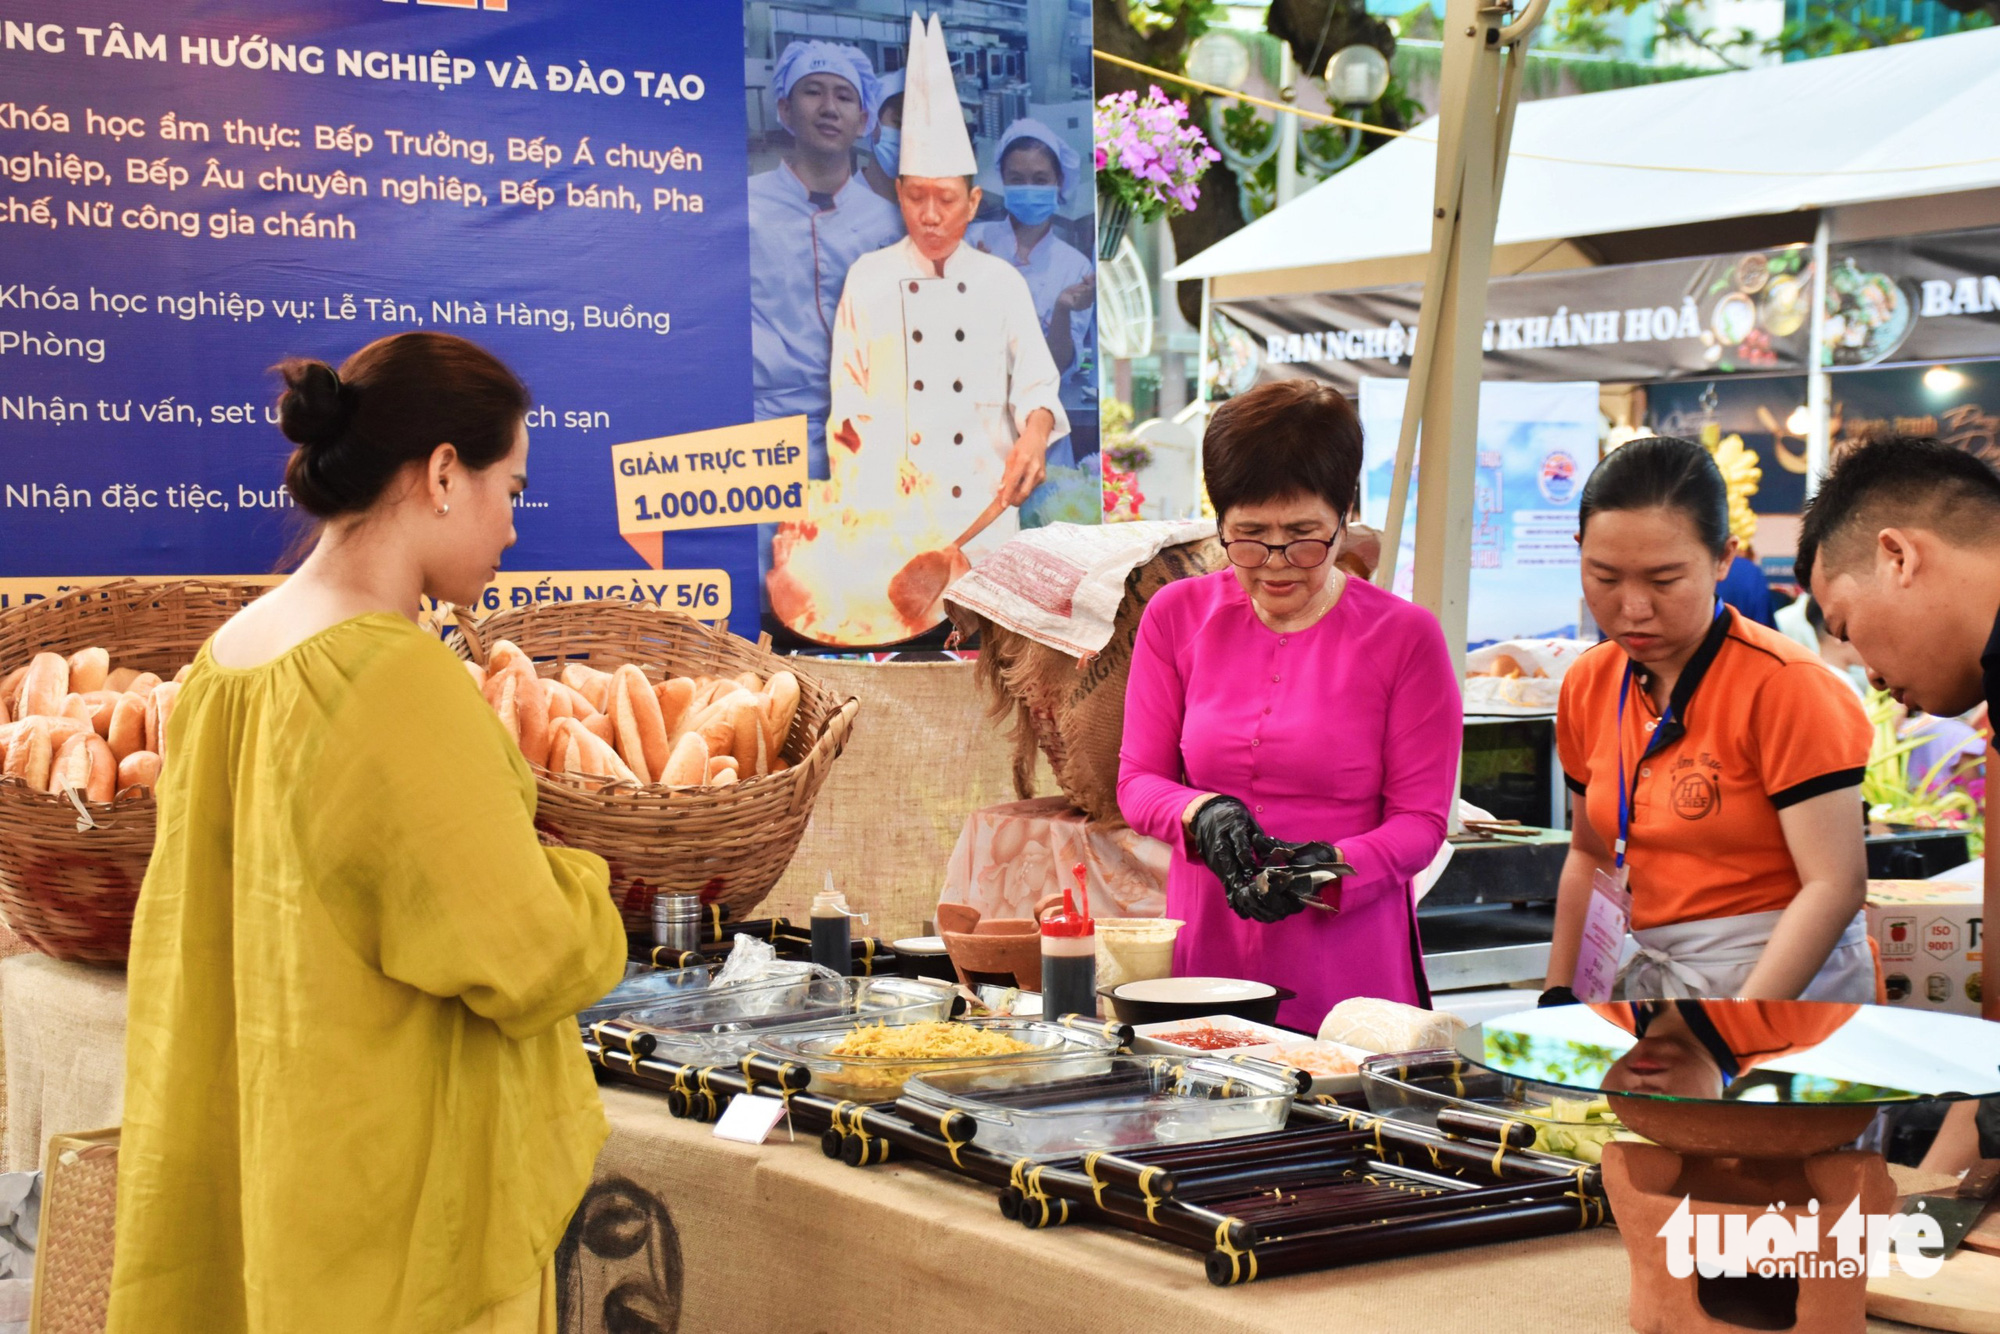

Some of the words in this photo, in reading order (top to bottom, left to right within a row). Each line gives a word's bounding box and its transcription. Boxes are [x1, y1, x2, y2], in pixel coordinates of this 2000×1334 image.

[0, 20, 65, 53] NG
[76, 22, 167, 62] TÂM
[180, 34, 325, 75] HƯỚNG
[336, 48, 477, 91] NGHIỆP
[485, 55, 539, 91] VÀ
[545, 59, 626, 96] ĐÀO
[633, 70, 706, 106] TẠO
[86, 107, 146, 142] học
[160, 111, 210, 142] ẩm
[223, 118, 301, 152] thực:
[314, 124, 374, 157] Bếp
[384, 130, 495, 165] Trưởng,
[507, 136, 562, 169] Bếp
[573, 136, 595, 165] Á
[605, 142, 703, 175] chuyên
[126, 157, 190, 191] Bếp
[201, 157, 245, 190] Âu
[258, 165, 368, 199] chuyên
[500, 178, 555, 211] Bếp
[566, 182, 642, 214] bánh,
[653, 187, 704, 213] Pha
[66, 200, 114, 228] Nữ
[121, 203, 201, 237] công
[208, 207, 255, 239] gia
[262, 210, 356, 239] chánh
[0, 284, 79, 311] Khóa
[90, 286, 148, 319] học
[157, 290, 265, 322] nghiệp
[272, 299, 315, 324] vụ:
[324, 293, 358, 320] Lễ
[363, 297, 424, 326] Tân,
[432, 299, 488, 325] Nhà
[496, 302, 576, 332] Hàng,
[583, 303, 671, 335] Buồng
[0, 330, 105, 363] Phòng
[1266, 332, 1325, 364] BAN
[1493, 305, 1620, 352] KHÁNH
[1, 396, 88, 427] Nhận
[97, 399, 132, 422] tư
[139, 396, 203, 427] vấn,
[210, 402, 256, 424] set
[564, 411, 610, 433] sạn
[619, 451, 679, 477] GIẢM
[685, 448, 746, 474] TRỰC
[752, 440, 801, 467] TIẾP
[6, 483, 92, 513] Nhận
[101, 483, 158, 513] đặc
[166, 483, 230, 513] tiệc,
[634, 482, 803, 521] 1.000.000đ
[510, 577, 573, 606] ĐẾN
[584, 578, 668, 607] NGÀY
[677, 583, 720, 609] 5/6
[1927, 941, 1954, 951] 9001
[1932, 926, 1951, 936] ISO
